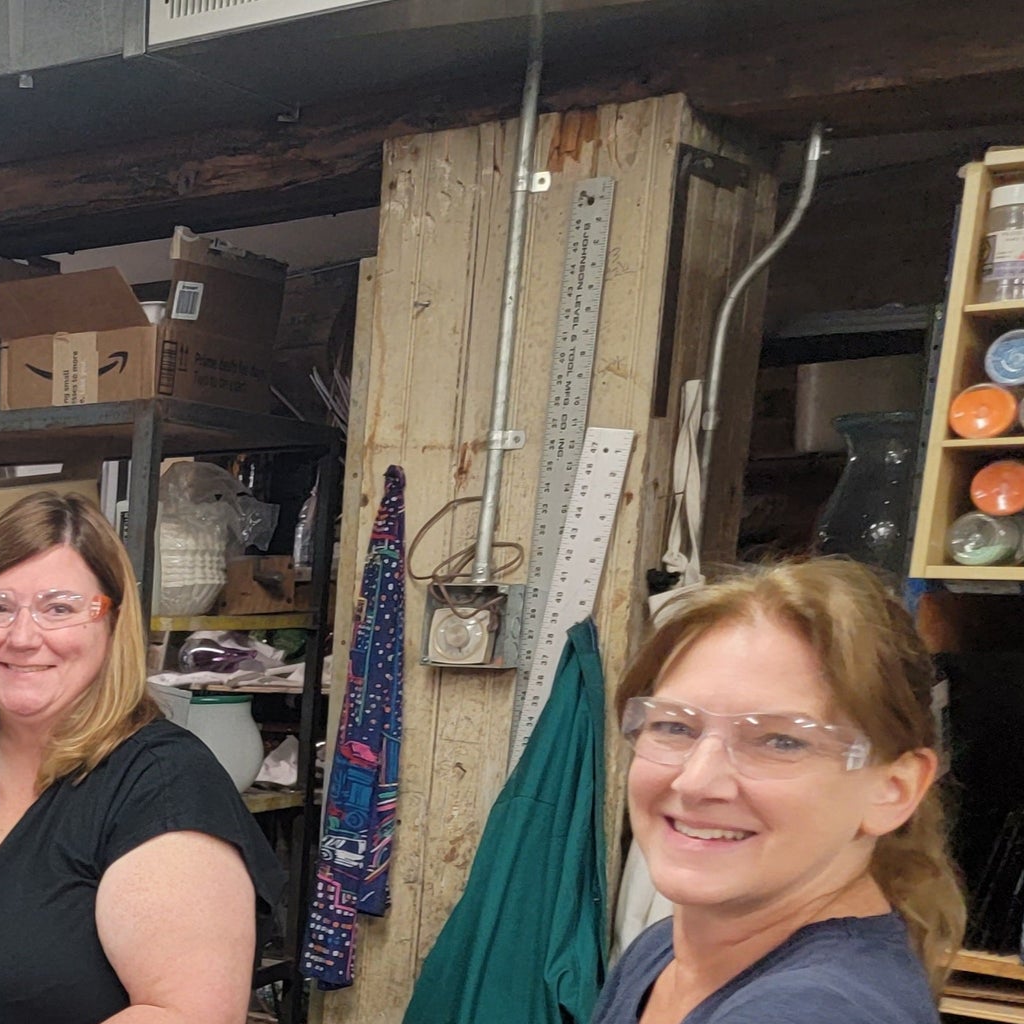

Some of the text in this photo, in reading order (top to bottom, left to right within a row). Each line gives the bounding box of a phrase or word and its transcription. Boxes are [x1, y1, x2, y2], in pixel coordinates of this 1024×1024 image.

[577, 232, 589, 290] JOHNSON
[572, 294, 582, 330] LEVEL
[566, 347, 576, 377] TOOL
